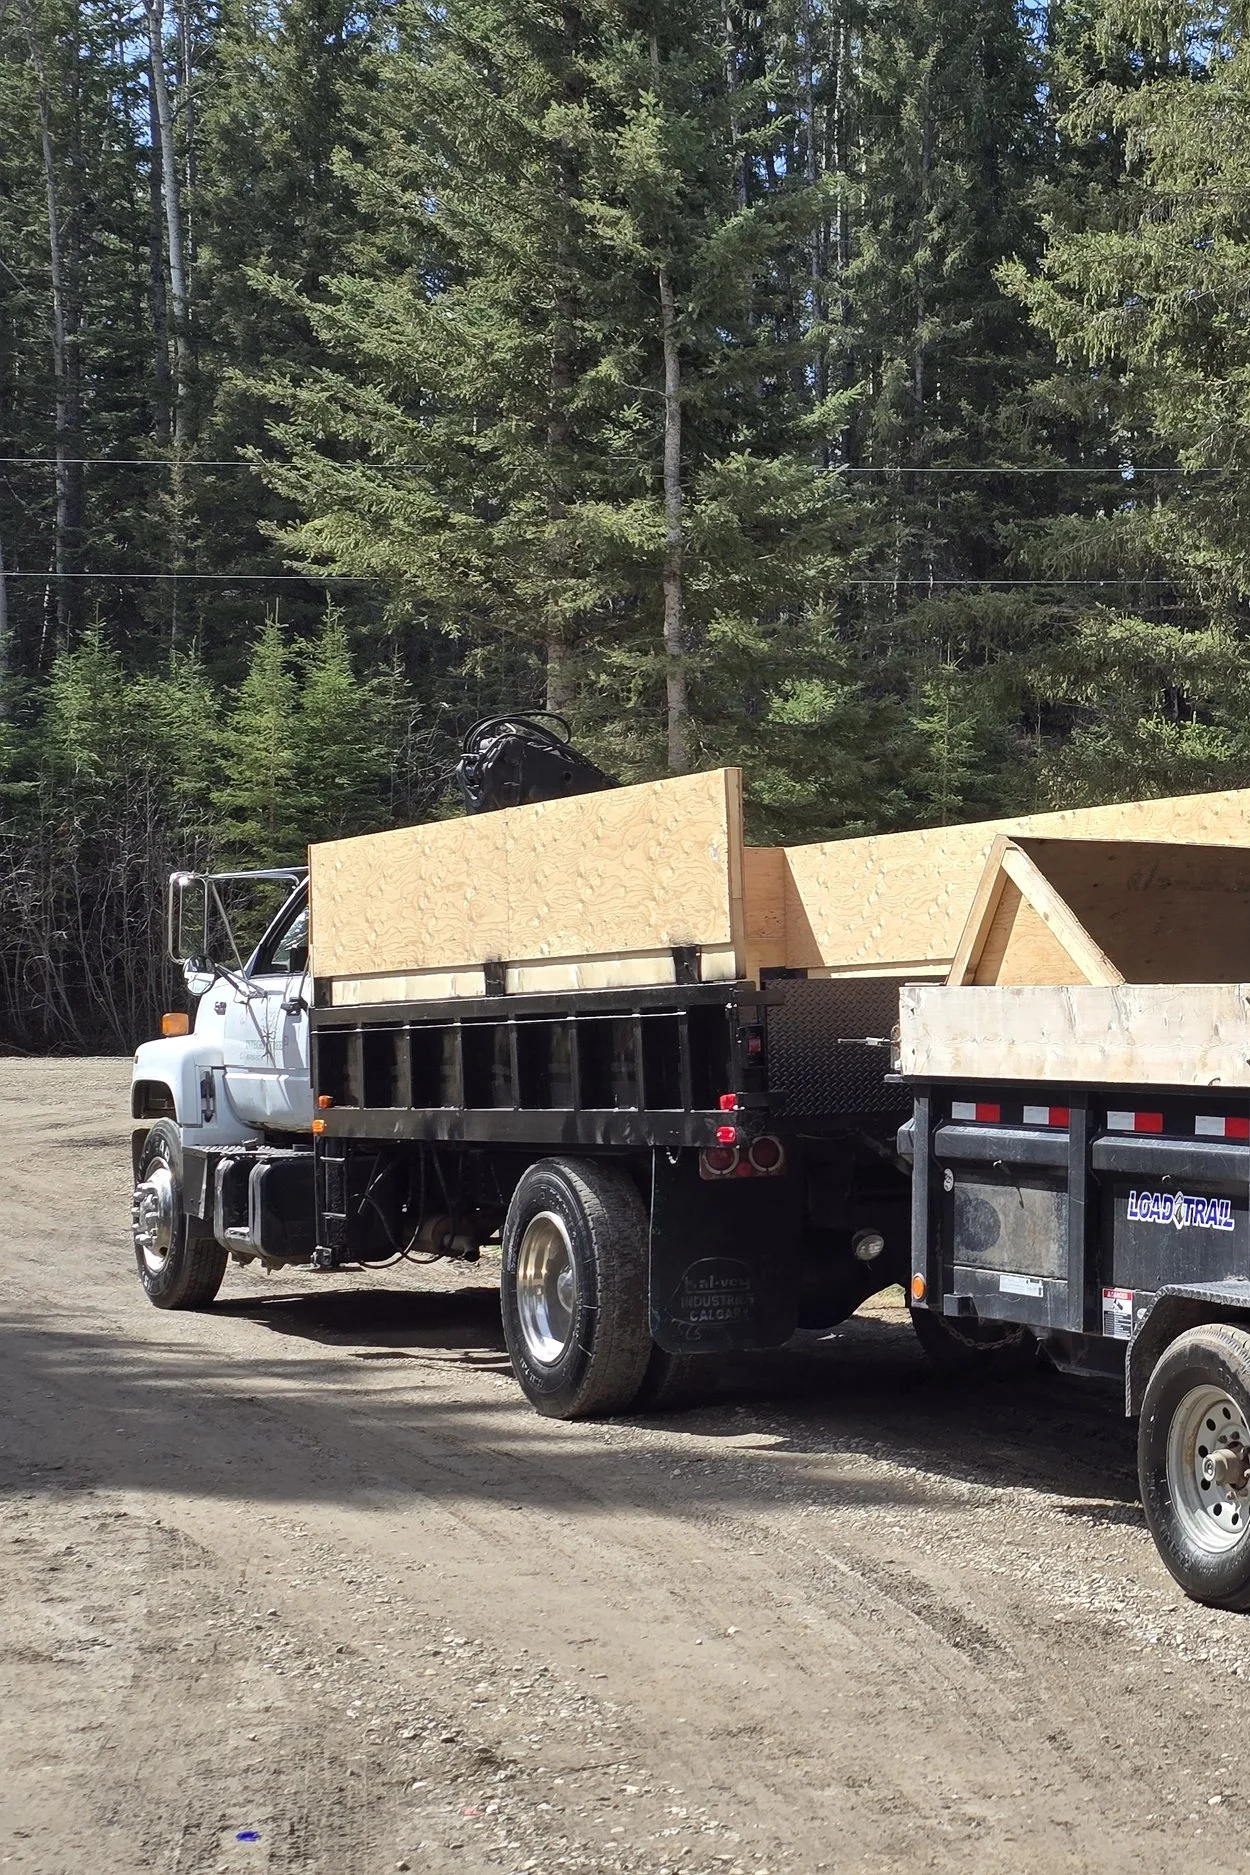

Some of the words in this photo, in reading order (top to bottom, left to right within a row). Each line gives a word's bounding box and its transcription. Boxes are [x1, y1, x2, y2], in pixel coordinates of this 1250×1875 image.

[1127, 1191, 1175, 1224] LOAD
[1182, 1196, 1234, 1231] TRAIL
[681, 1293, 755, 1308] INDUSTRIES
[690, 1308, 749, 1321] CALGARY
